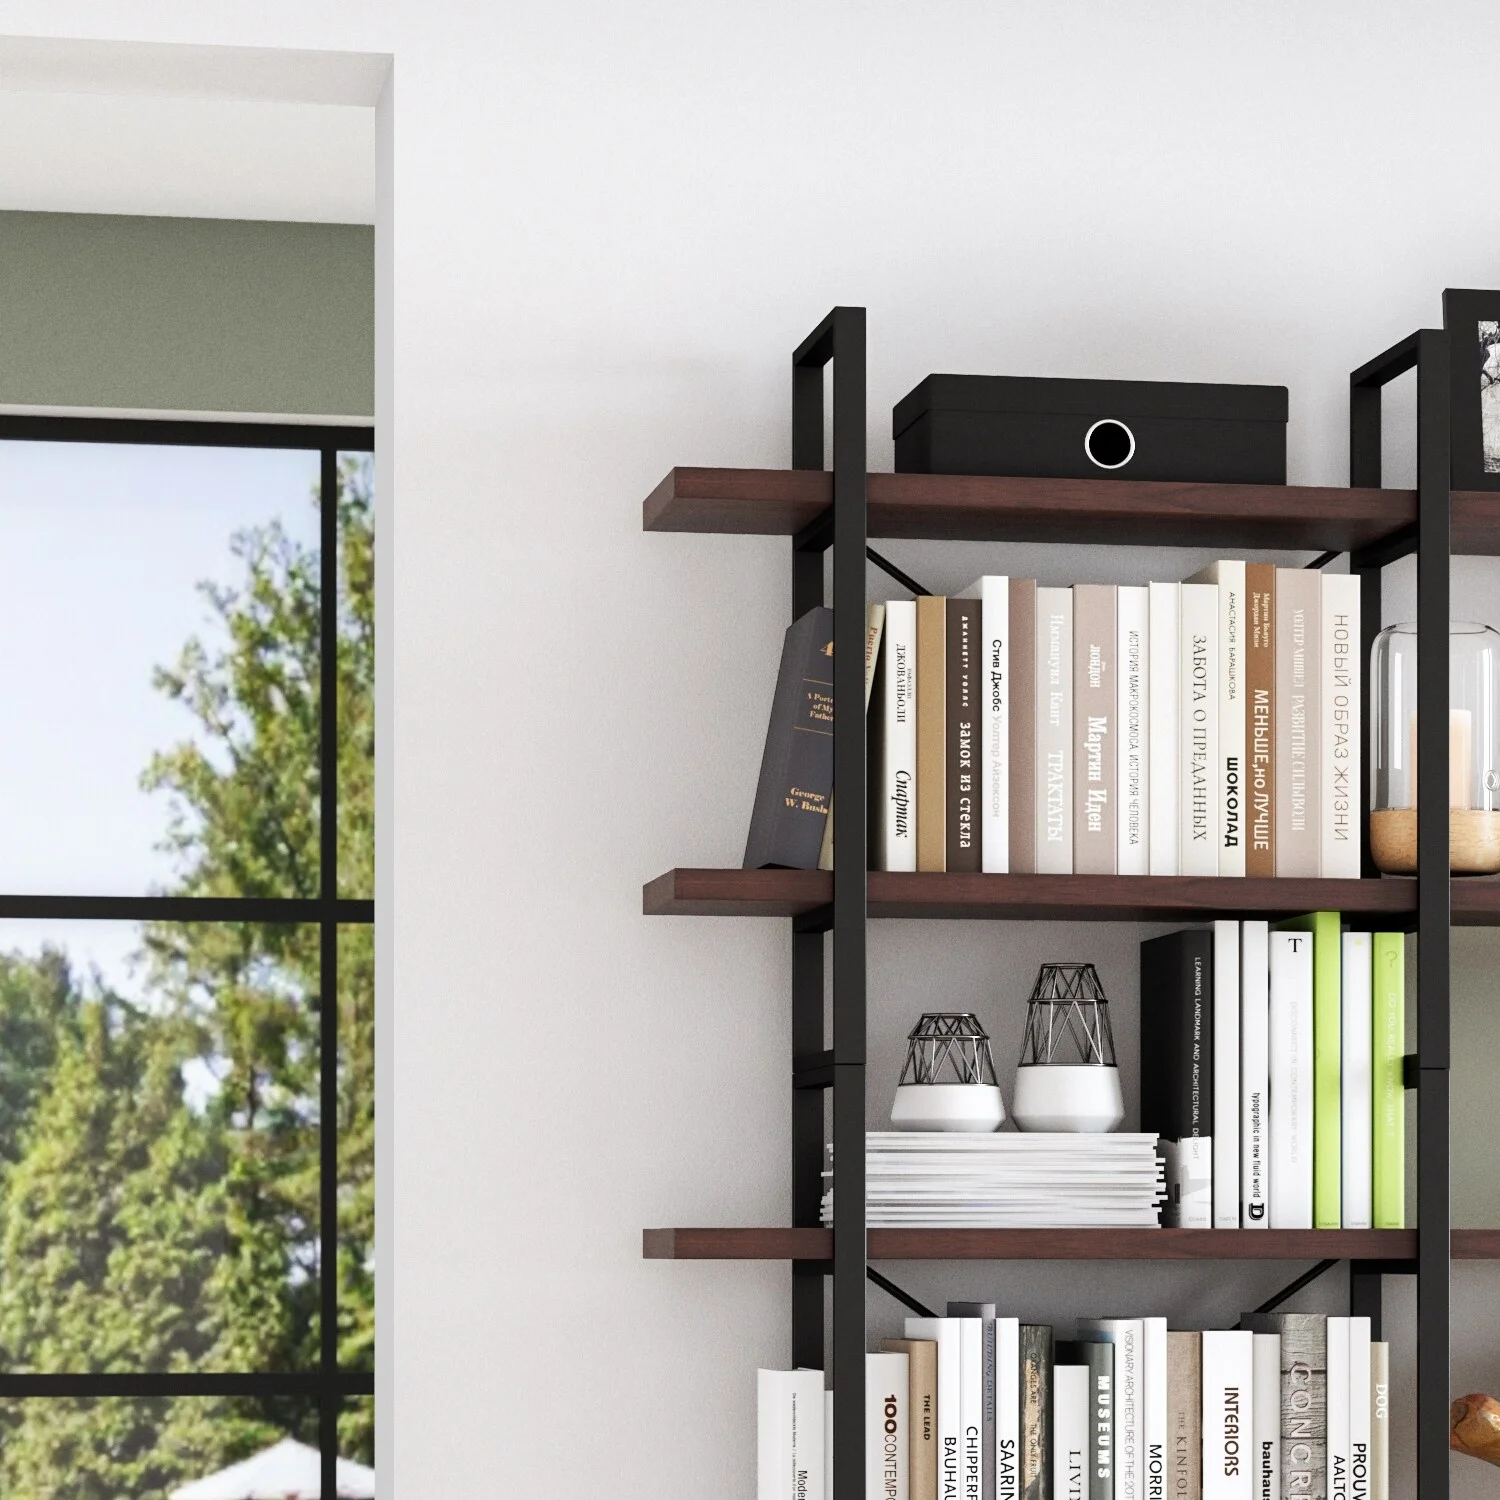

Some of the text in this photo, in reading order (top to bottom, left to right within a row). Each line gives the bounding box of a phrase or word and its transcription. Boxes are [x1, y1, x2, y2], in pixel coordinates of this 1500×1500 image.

[990, 639, 1002, 712] Стив Джобс
[1190, 634, 1207, 841] ЗАБОТА ПРЕДАННЫХ
[1333, 614, 1352, 841] НОВЫЙ ОБРАЗ ЖИЗНИ
[891, 770, 912, 838] Спартак
[1046, 750, 1064, 842] ТРАКТАТЫ
[1084, 716, 1107, 832] Мартин Иден
[1224, 756, 1238, 847] ШОКОЛАД
[1252, 791, 1269, 850] ЛУЧШЕ
[1191, 956, 1201, 1132] LEARNING LANDMARK AND ARCHITECTURAL
[1251, 1092, 1261, 1198] typographic world
[1124, 1329, 1135, 1375] VISIONARY
[923, 1394, 931, 1441] THE LEAD
[1097, 1375, 1111, 1479] MUSEUMS
[1124, 1375, 1135, 1444] ARCHITECTURE
[1224, 1387, 1239, 1477] INTERIORS
[1375, 1383, 1388, 1419] DOG
[1124, 1460, 1135, 1480] THE
